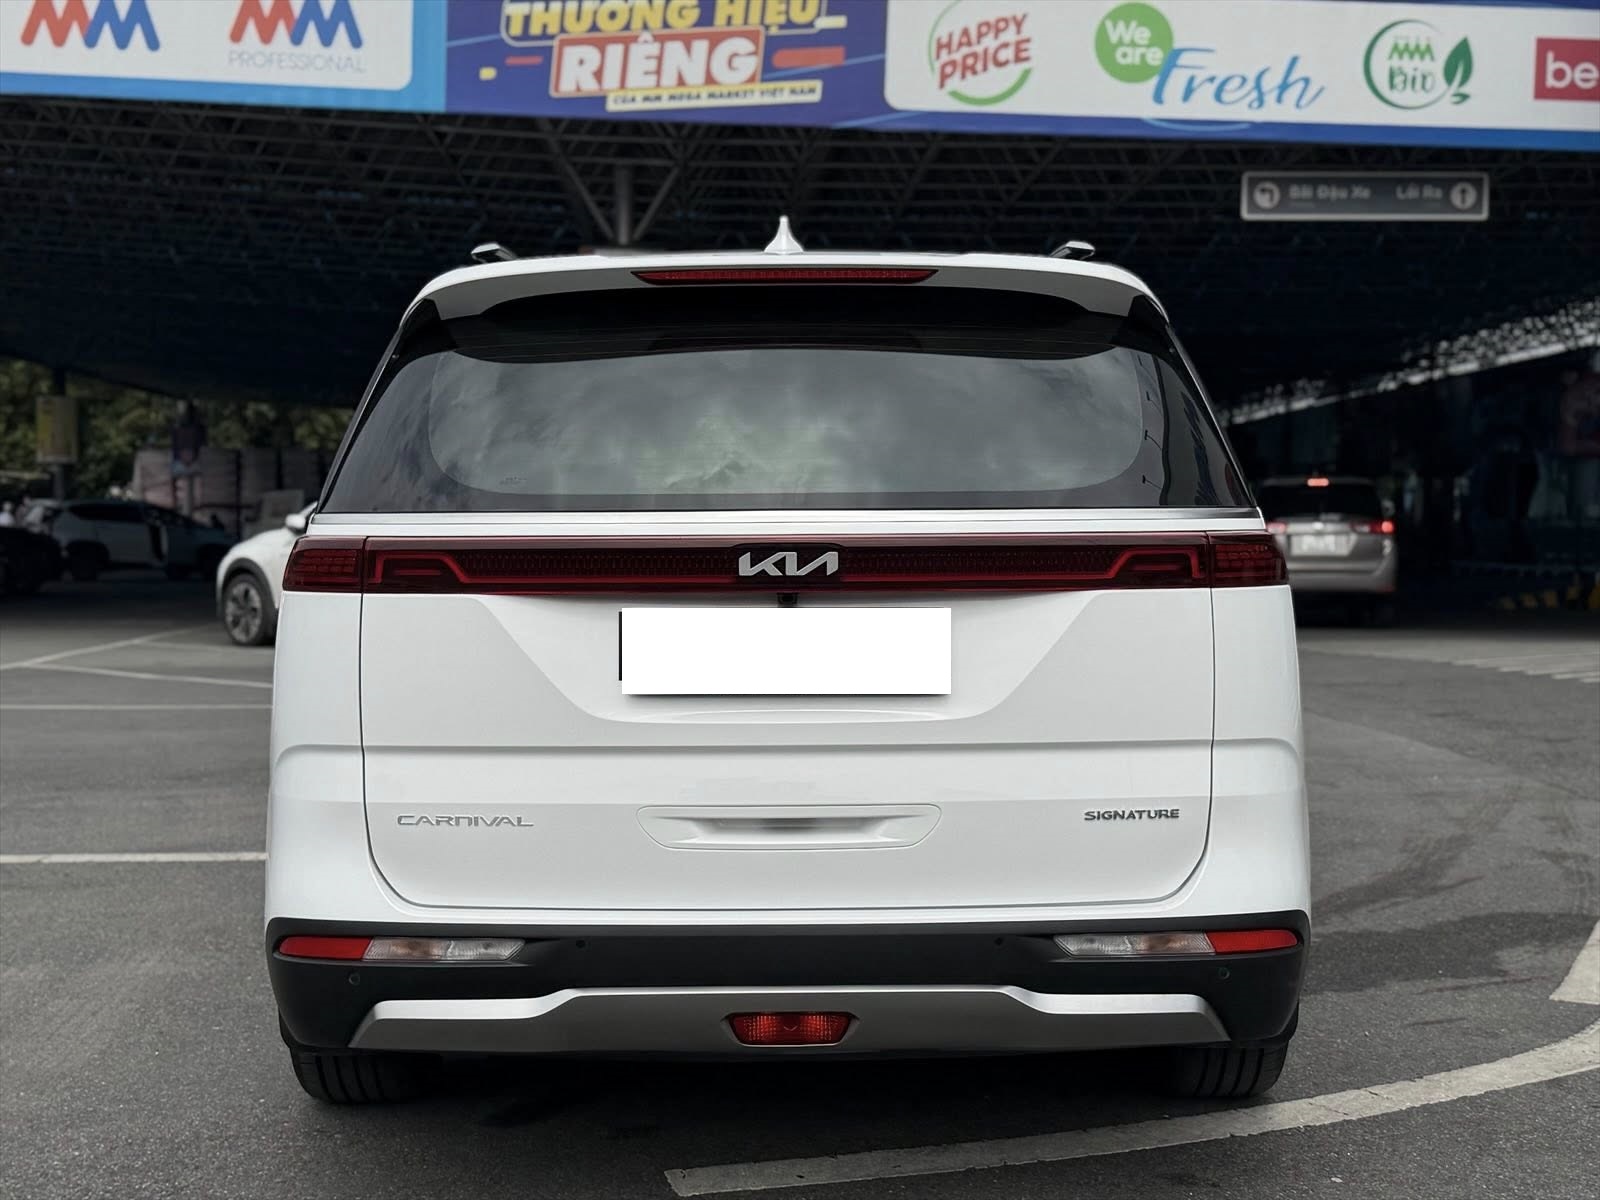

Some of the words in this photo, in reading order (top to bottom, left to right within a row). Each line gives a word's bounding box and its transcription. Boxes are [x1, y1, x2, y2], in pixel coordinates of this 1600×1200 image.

[935, 13, 1029, 61] HAPPY
[1104, 20, 1152, 45] We
[228, 50, 367, 74] PROFESSIONAL
[558, 32, 759, 92] RIÊNG
[937, 37, 1032, 90] PRICE
[1115, 46, 1164, 67] are
[1152, 48, 1325, 110] Fresh
[739, 552, 838, 576] KIA
[397, 815, 534, 827] CARNIVAL
[1084, 809, 1180, 821] SIGNATURE
